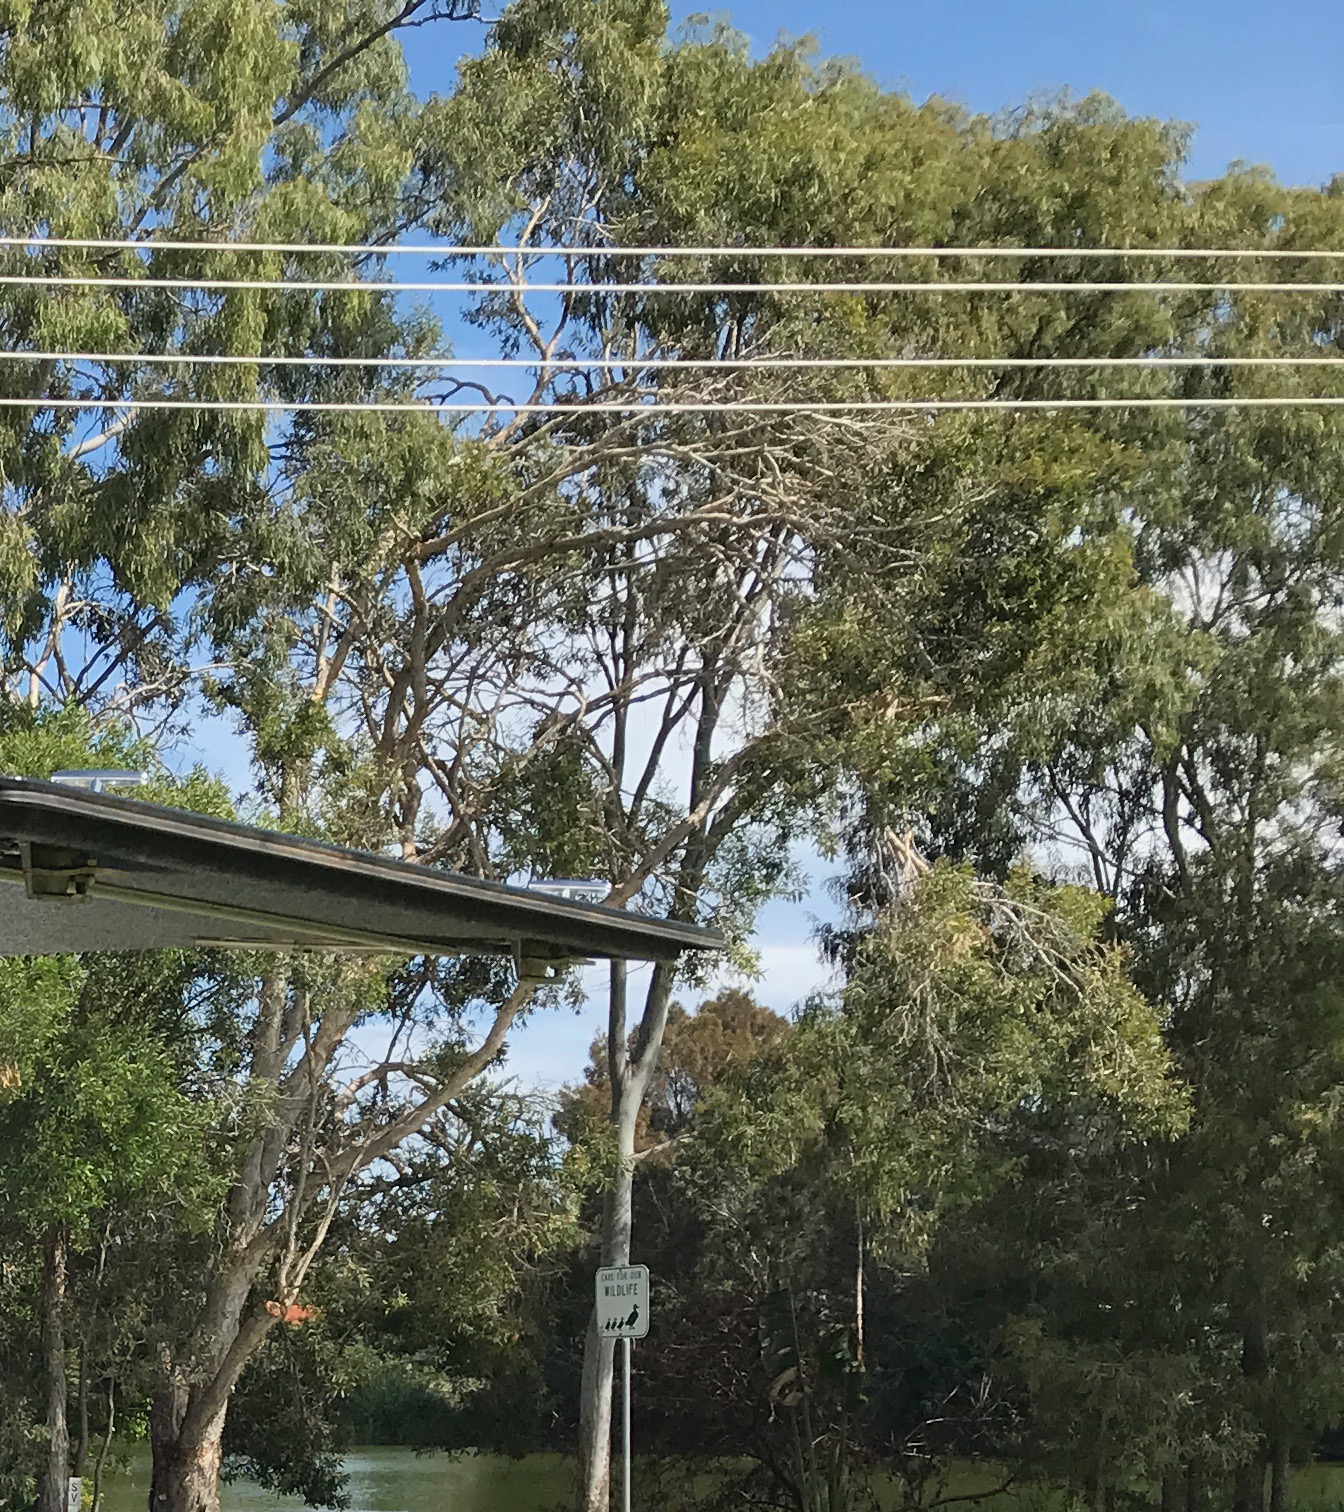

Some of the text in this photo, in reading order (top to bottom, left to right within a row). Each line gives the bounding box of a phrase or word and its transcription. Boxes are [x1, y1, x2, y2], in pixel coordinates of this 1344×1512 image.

[601, 1271, 642, 1281] CARE FOR OUR
[604, 1283, 638, 1297] WILDLIFE
